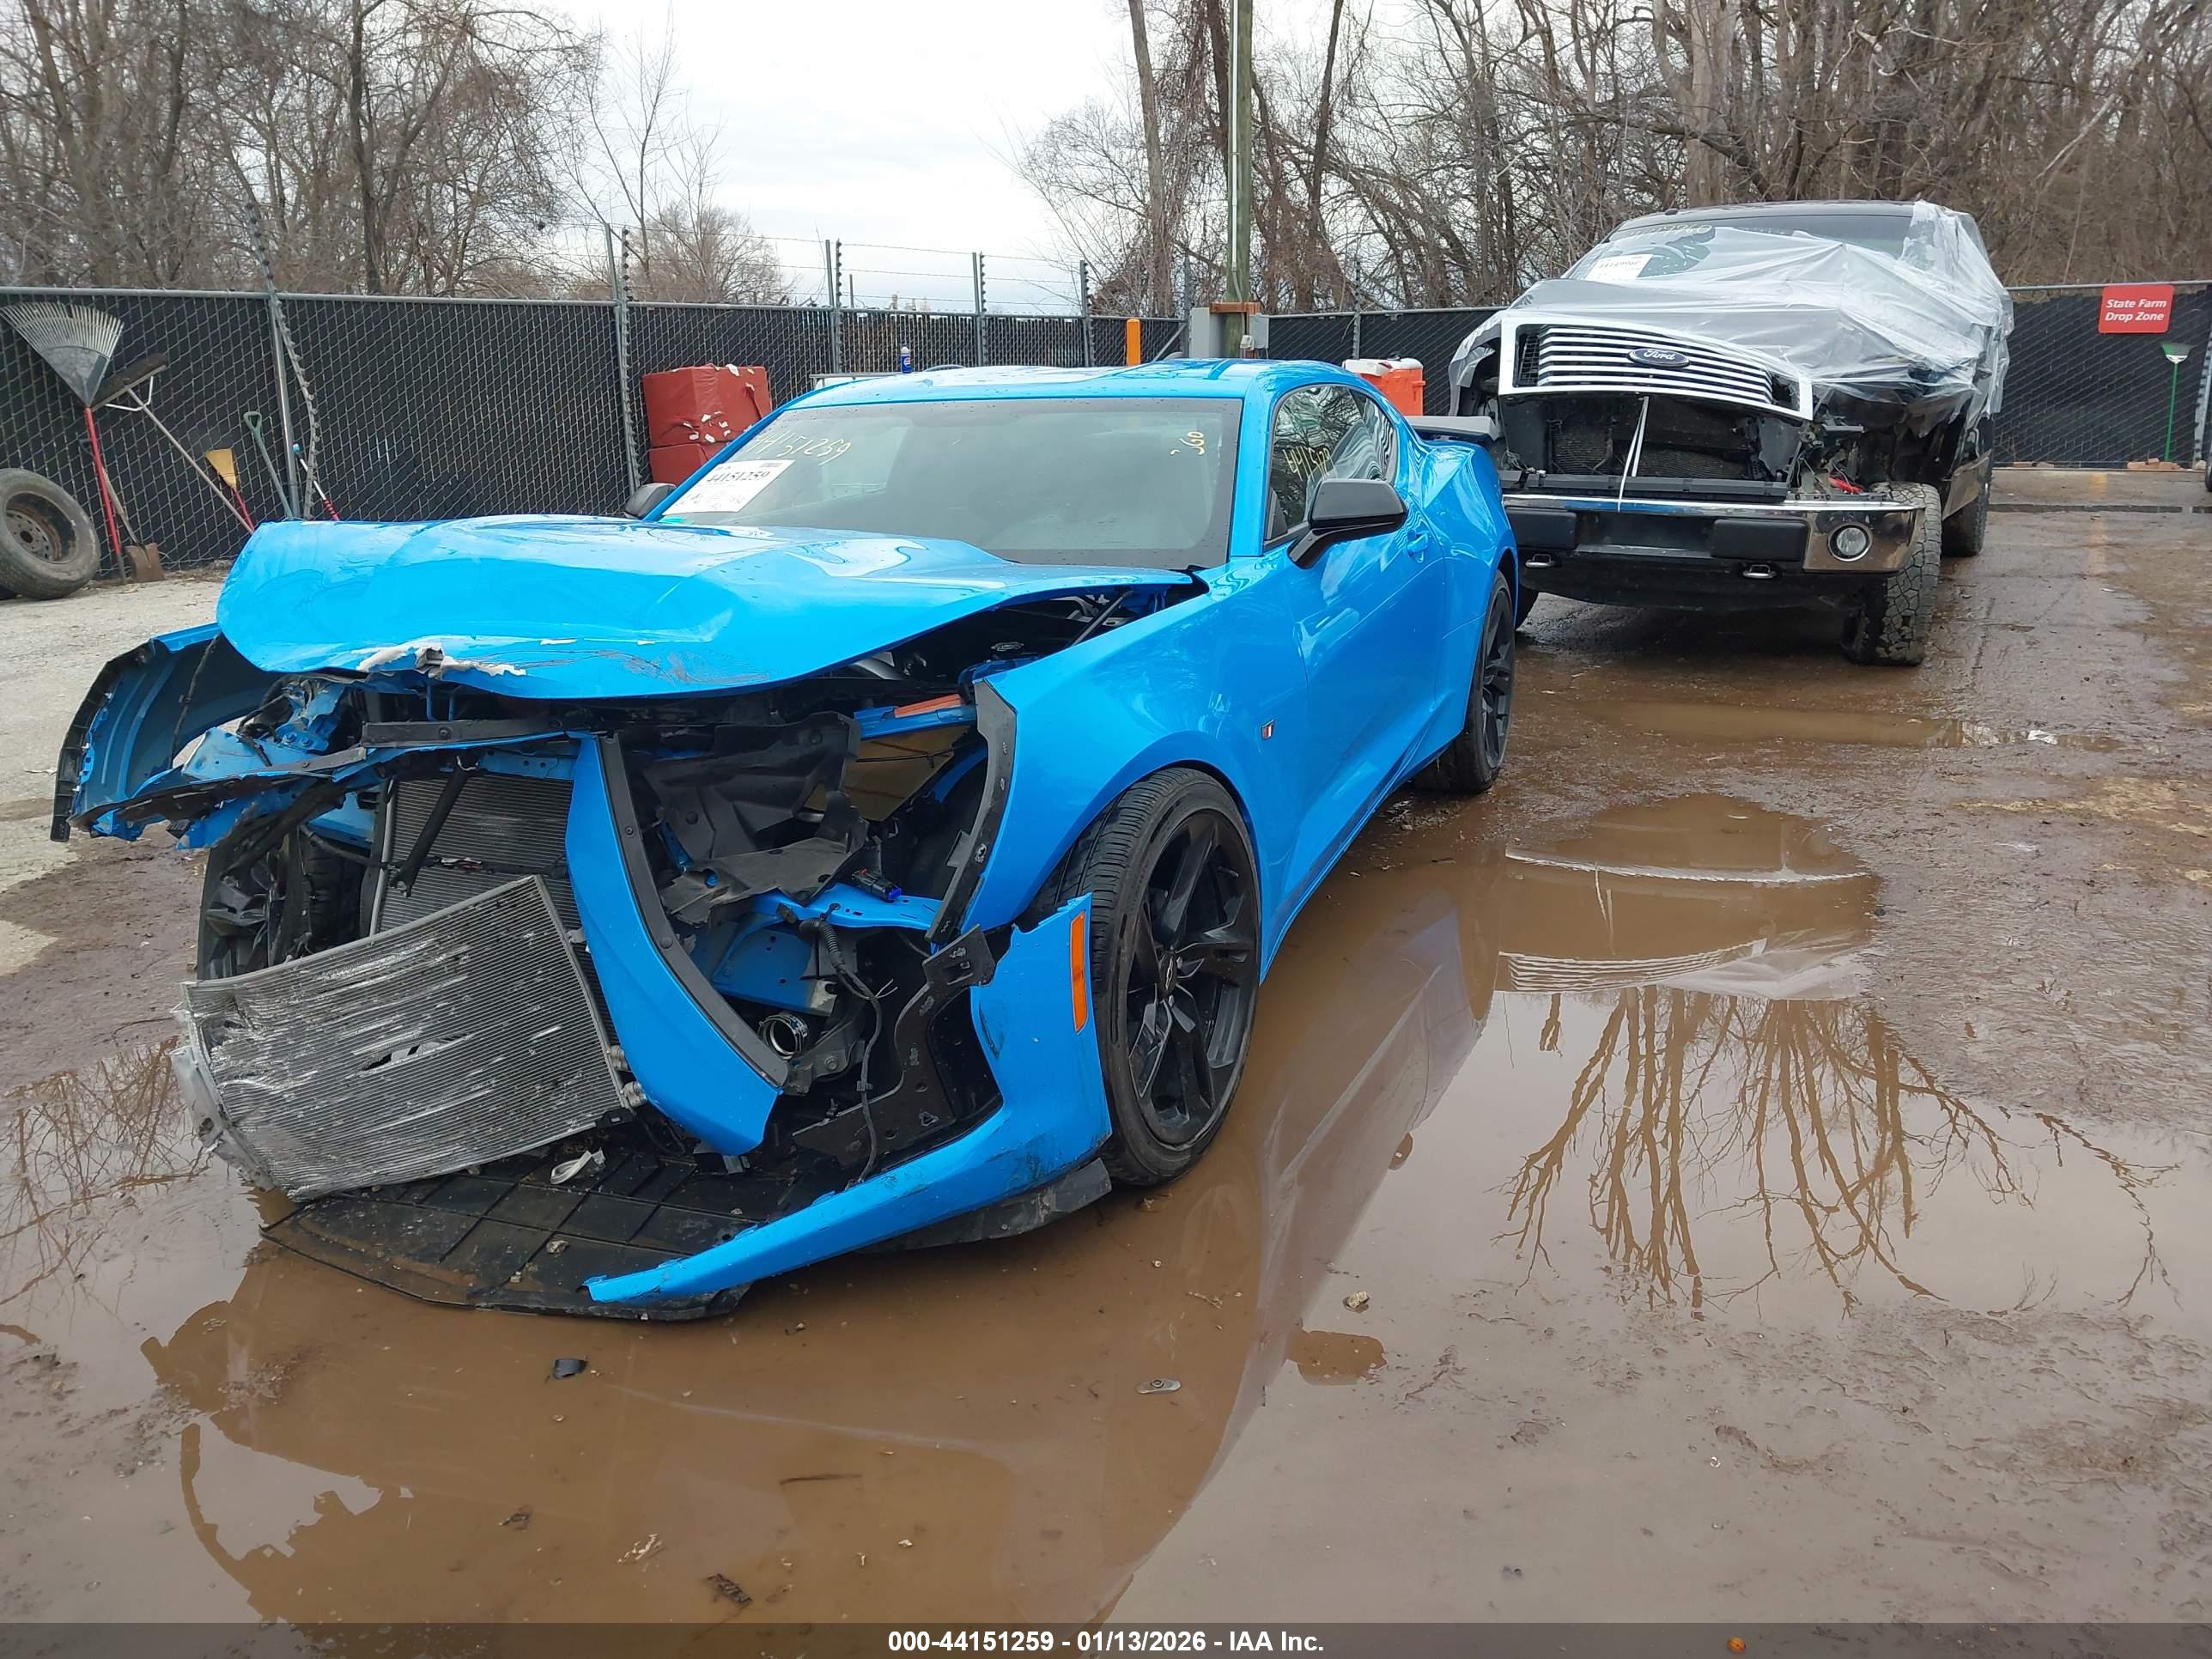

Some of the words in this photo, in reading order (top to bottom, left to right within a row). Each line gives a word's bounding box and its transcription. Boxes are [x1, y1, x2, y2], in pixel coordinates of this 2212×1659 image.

[2106, 299, 2136, 308] State
[2138, 299, 2167, 308] Farm
[2105, 312, 2134, 323] Drop
[2135, 312, 2165, 321] Zone
[1643, 349, 1676, 361] Ford
[746, 428, 853, 466] 44151259
[707, 471, 771, 482] 44151259
